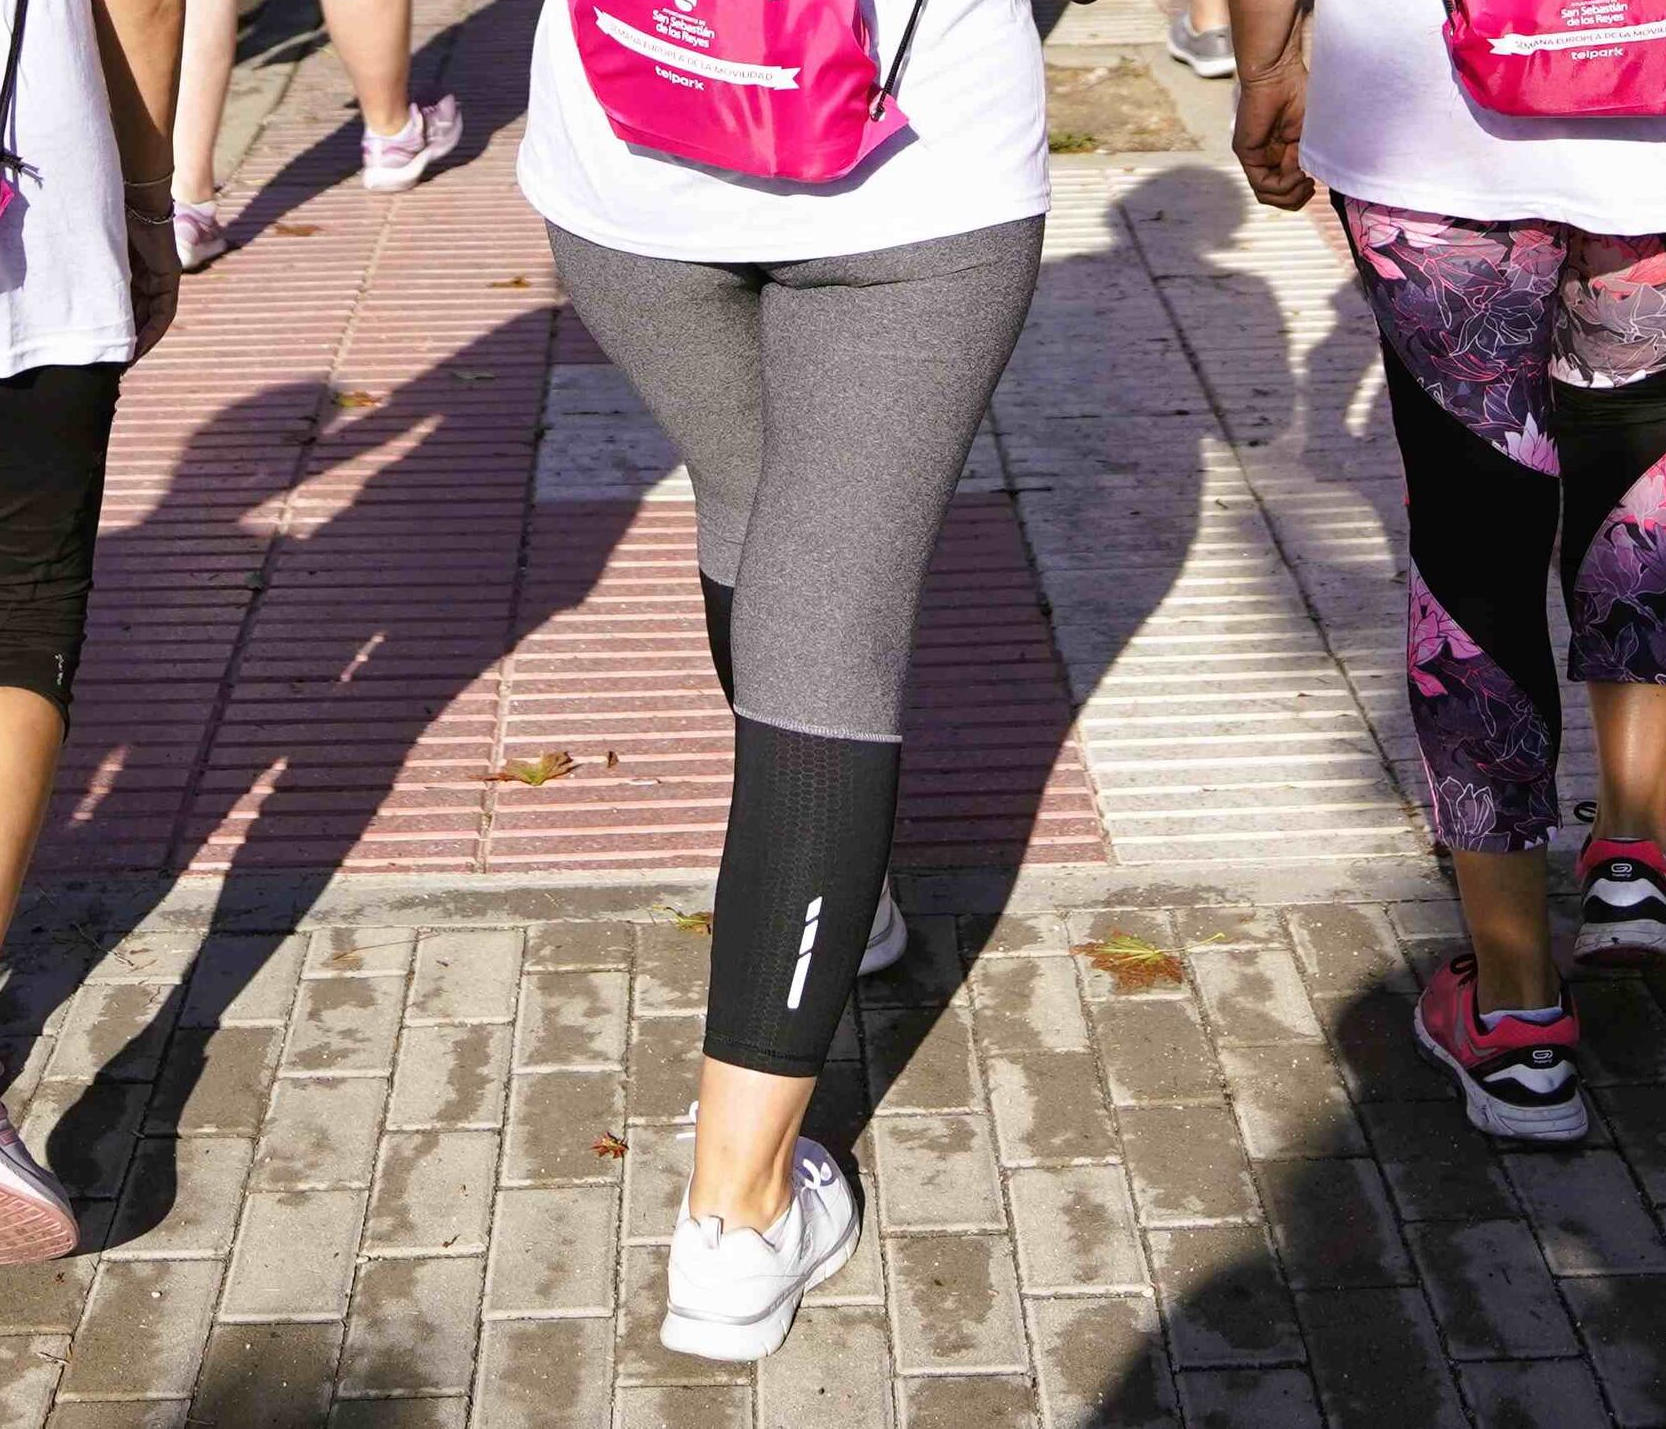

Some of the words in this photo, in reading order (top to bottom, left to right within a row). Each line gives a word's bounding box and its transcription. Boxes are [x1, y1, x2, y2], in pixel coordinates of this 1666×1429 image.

[652, 9, 670, 25] San
[1561, 8, 1579, 19] San
[1566, 17, 1580, 26] de
[1581, 16, 1594, 25] los
[1595, 13, 1624, 24] Reyes
[655, 22, 668, 34] de
[669, 25, 682, 40] los
[682, 30, 710, 48] Reyes
[1571, 47, 1624, 61] telpark
[655, 65, 705, 91] telpark
